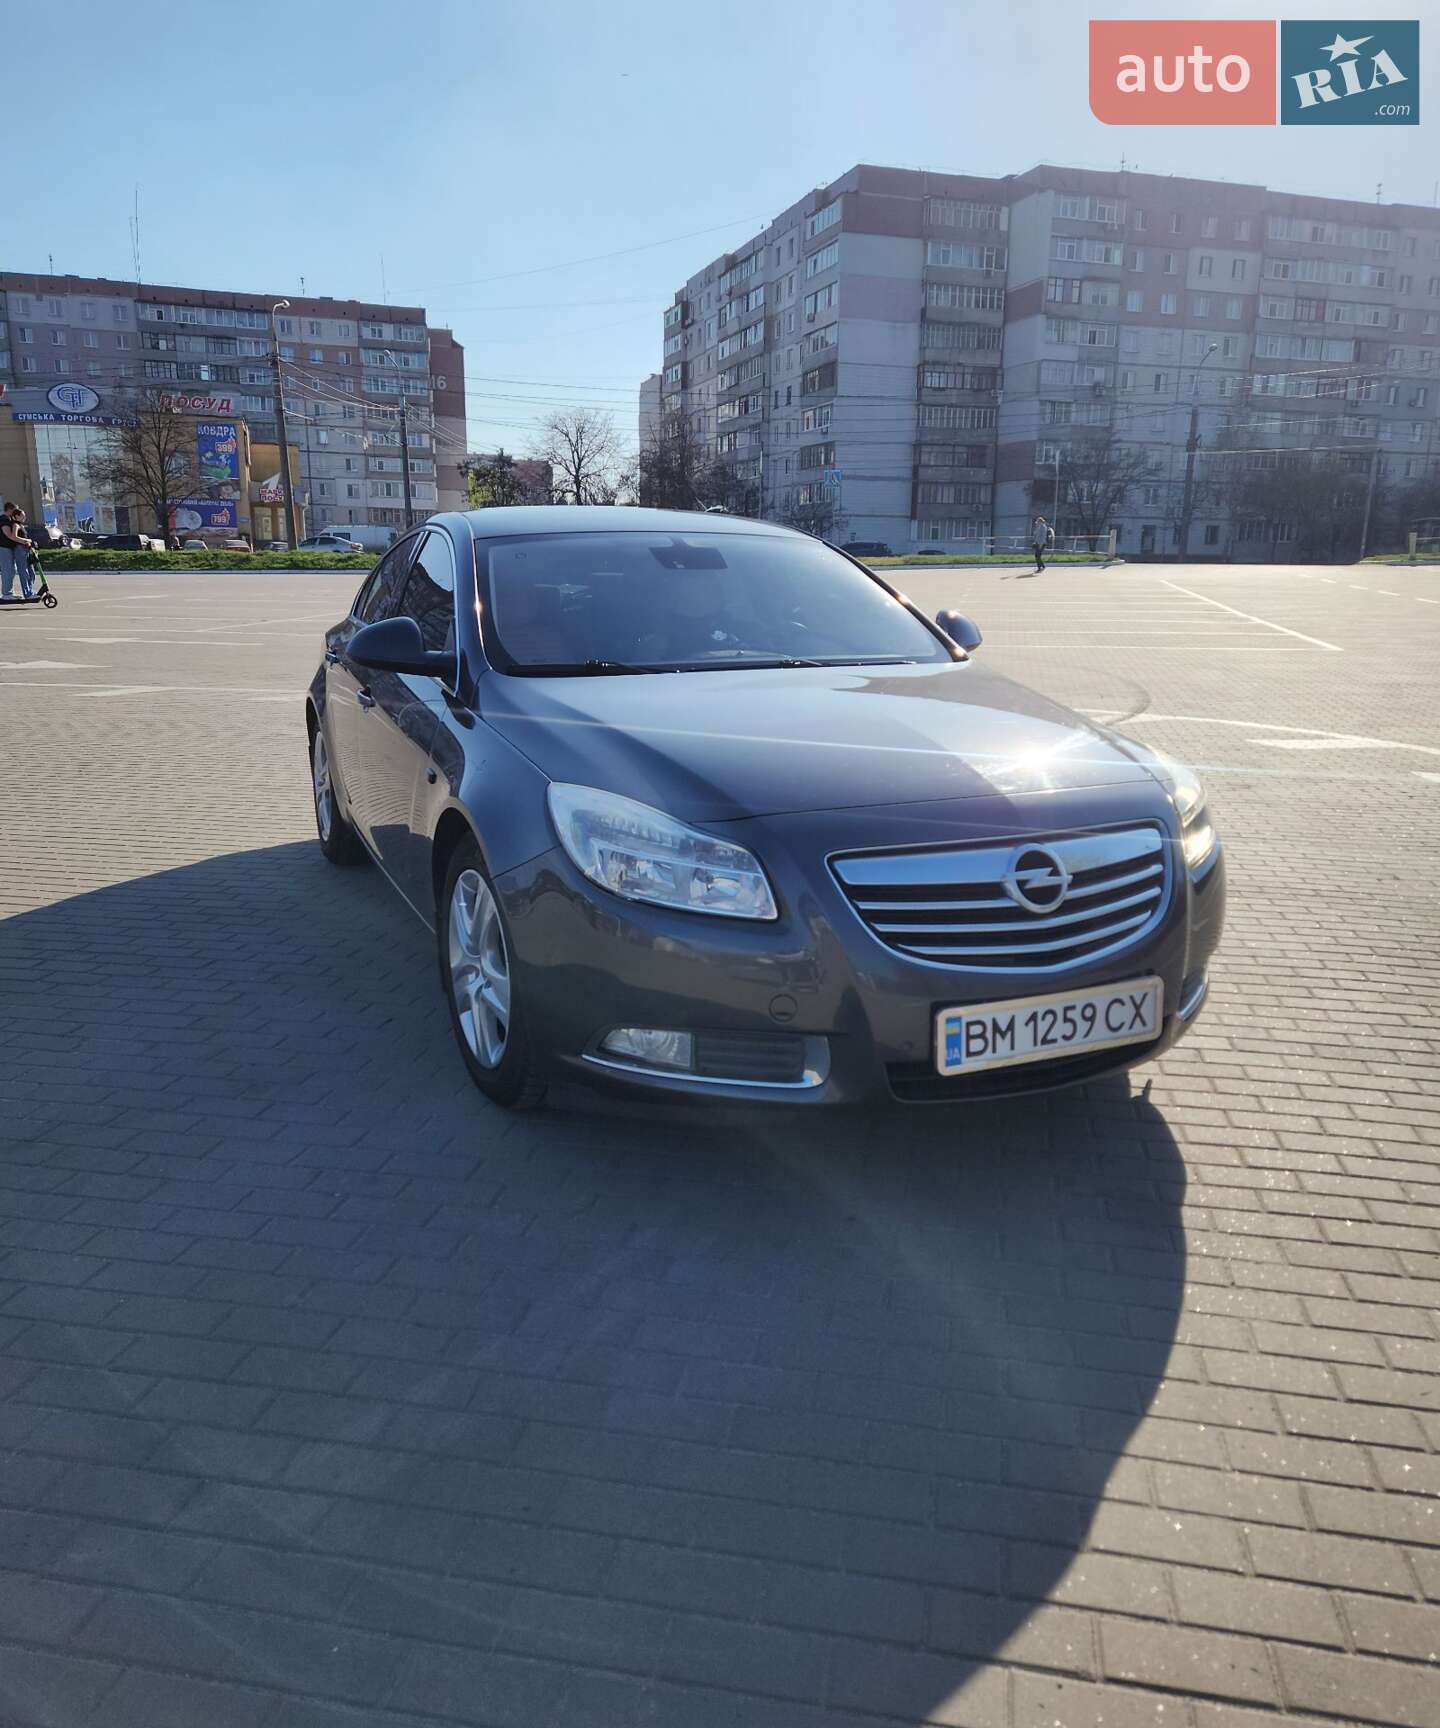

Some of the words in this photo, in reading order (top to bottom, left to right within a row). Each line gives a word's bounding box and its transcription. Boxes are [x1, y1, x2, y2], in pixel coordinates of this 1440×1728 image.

[160, 393, 232, 413] ПОСУД
[18, 413, 55, 422] СУМСЬКА
[60, 414, 105, 424] ТОРГОВА
[965, 1014, 1016, 1059] BM
[1024, 1002, 1098, 1047] 1259
[1104, 991, 1149, 1033] CX
